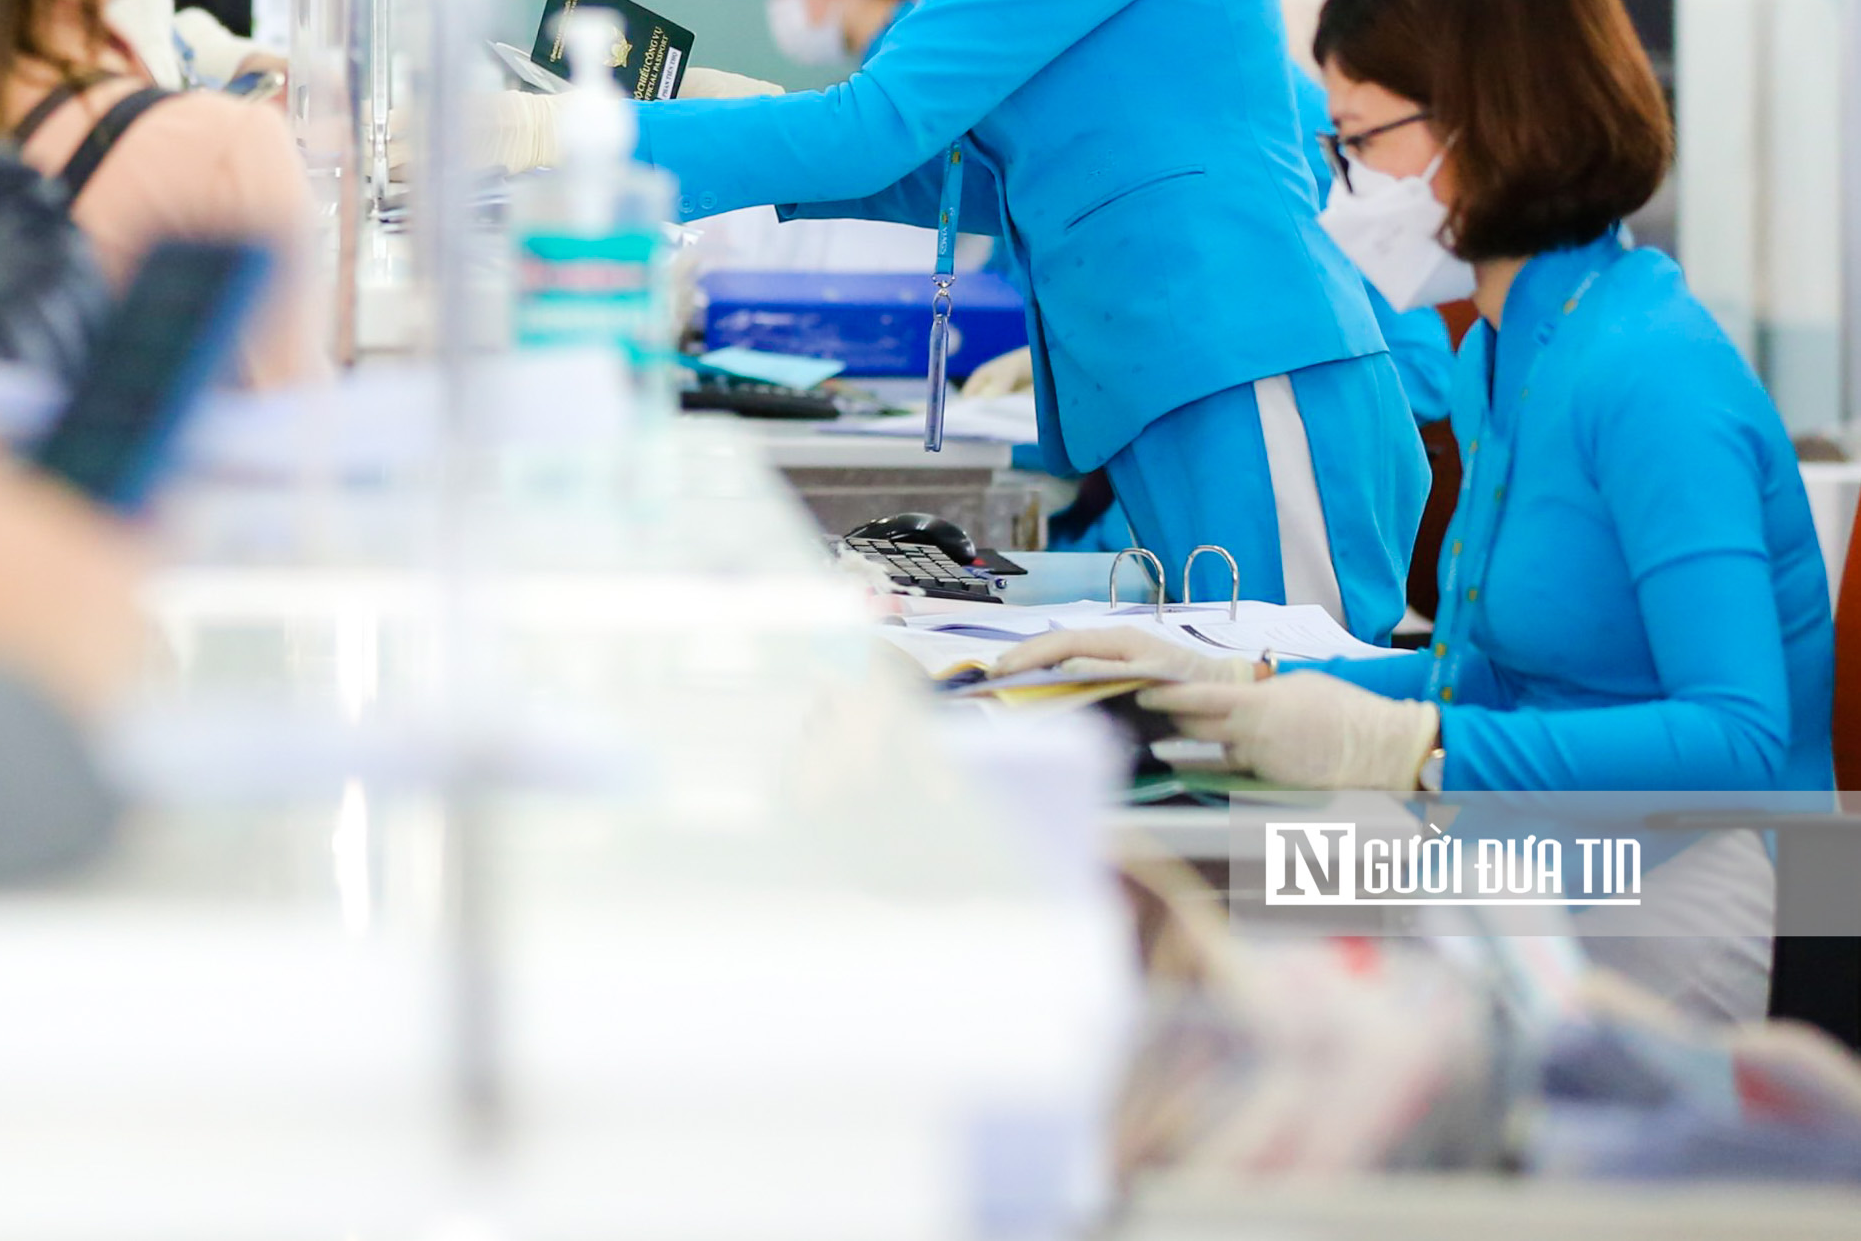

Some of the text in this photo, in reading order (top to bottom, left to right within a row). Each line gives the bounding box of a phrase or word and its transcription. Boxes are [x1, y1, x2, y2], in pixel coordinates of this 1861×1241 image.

[637, 64, 651, 92] CHIẾU
[644, 39, 658, 65] CÔNG
[652, 26, 664, 40] VỤ
[644, 34, 669, 100] FFICIAL PASSPORT
